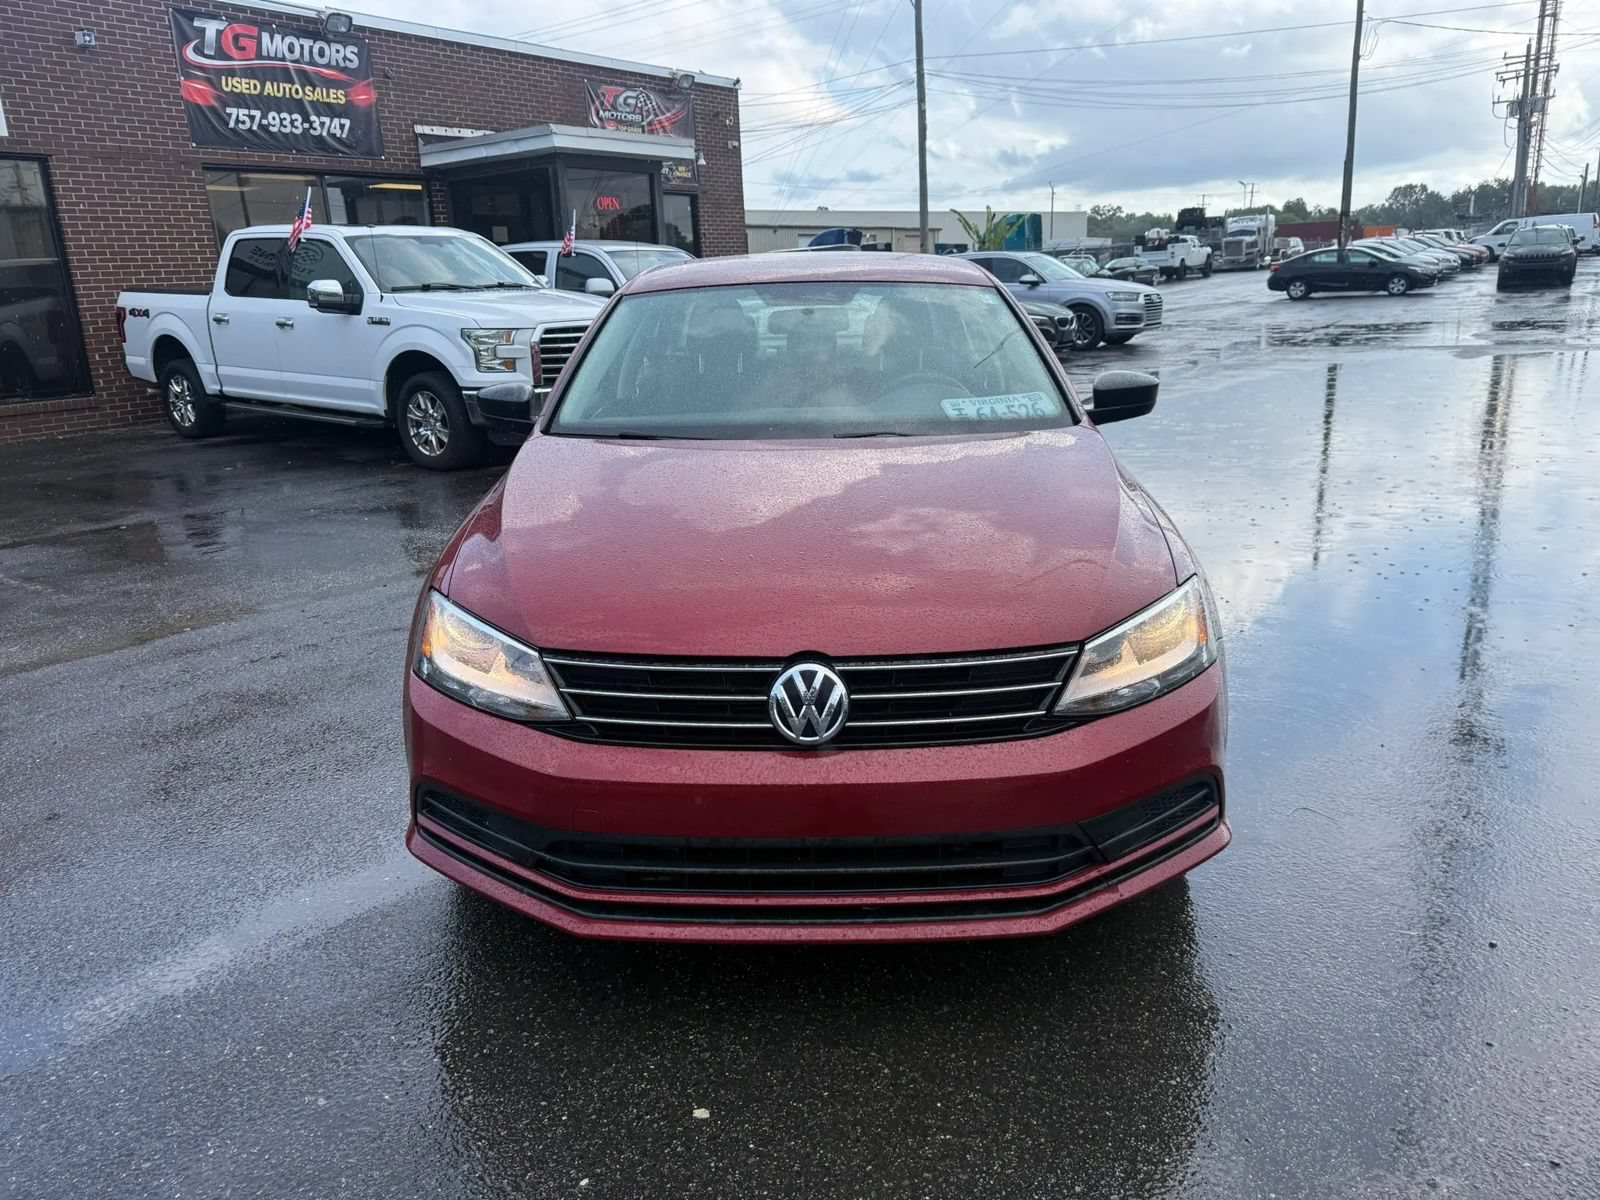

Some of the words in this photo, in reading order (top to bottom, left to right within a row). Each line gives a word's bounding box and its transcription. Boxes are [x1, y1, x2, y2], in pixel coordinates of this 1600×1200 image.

[193, 16, 258, 61] TG
[261, 32, 360, 69] MOTORS
[221, 76, 261, 96] USED
[263, 81, 303, 100] AUTO
[304, 85, 347, 104] SALES
[225, 107, 351, 139] 757-933-3747
[599, 110, 643, 122] MOTORS
[596, 197, 621, 210] OPEN
[970, 396, 1021, 406] VIRGINIA
